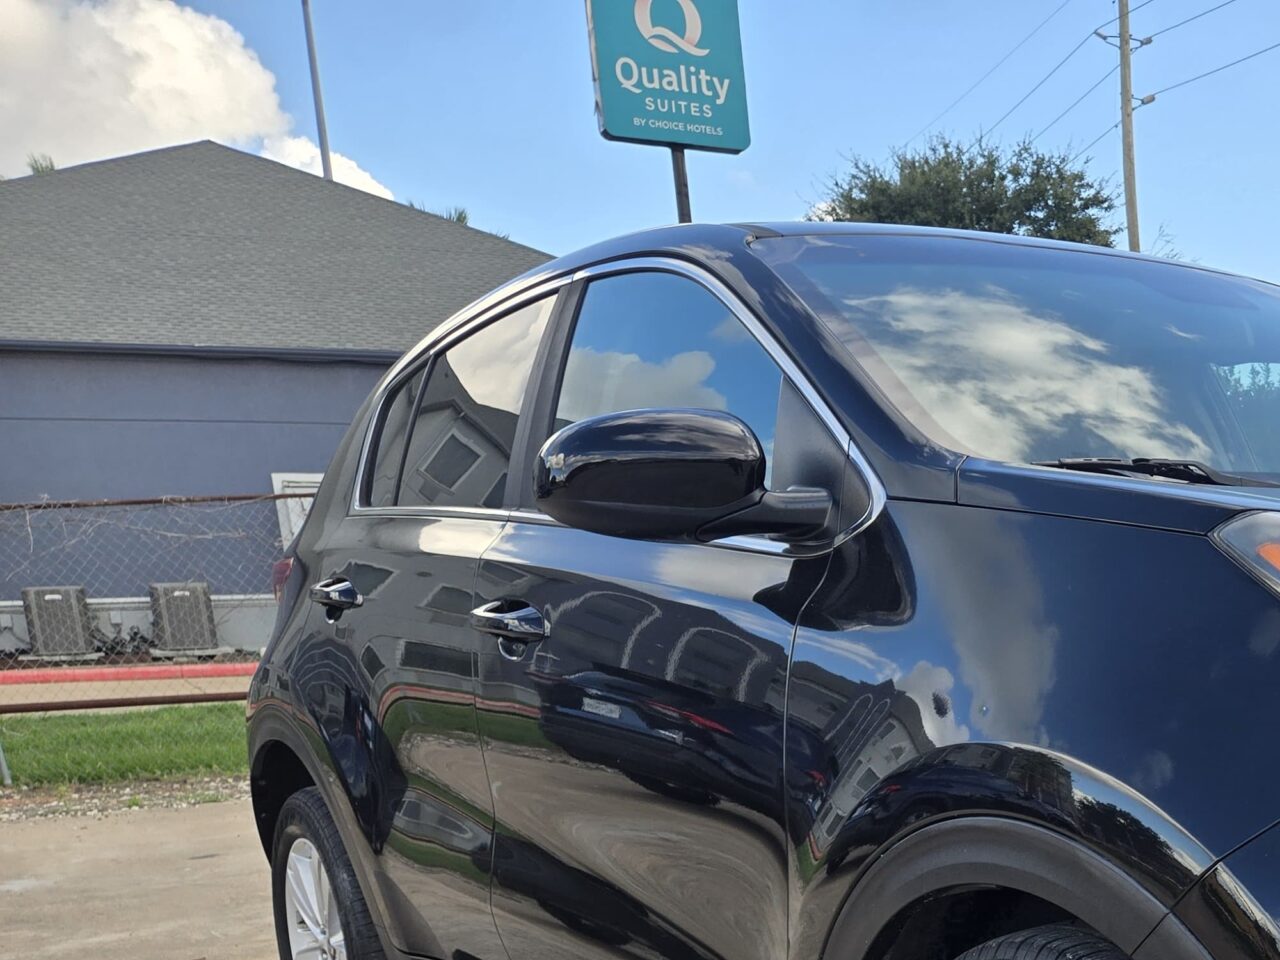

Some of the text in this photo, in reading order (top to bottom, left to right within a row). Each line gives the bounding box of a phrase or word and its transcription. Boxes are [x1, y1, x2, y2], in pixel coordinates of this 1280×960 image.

[615, 56, 730, 105] Quality
[645, 97, 713, 118] SUITES
[633, 117, 723, 136] BY CHOICE HOTELS
